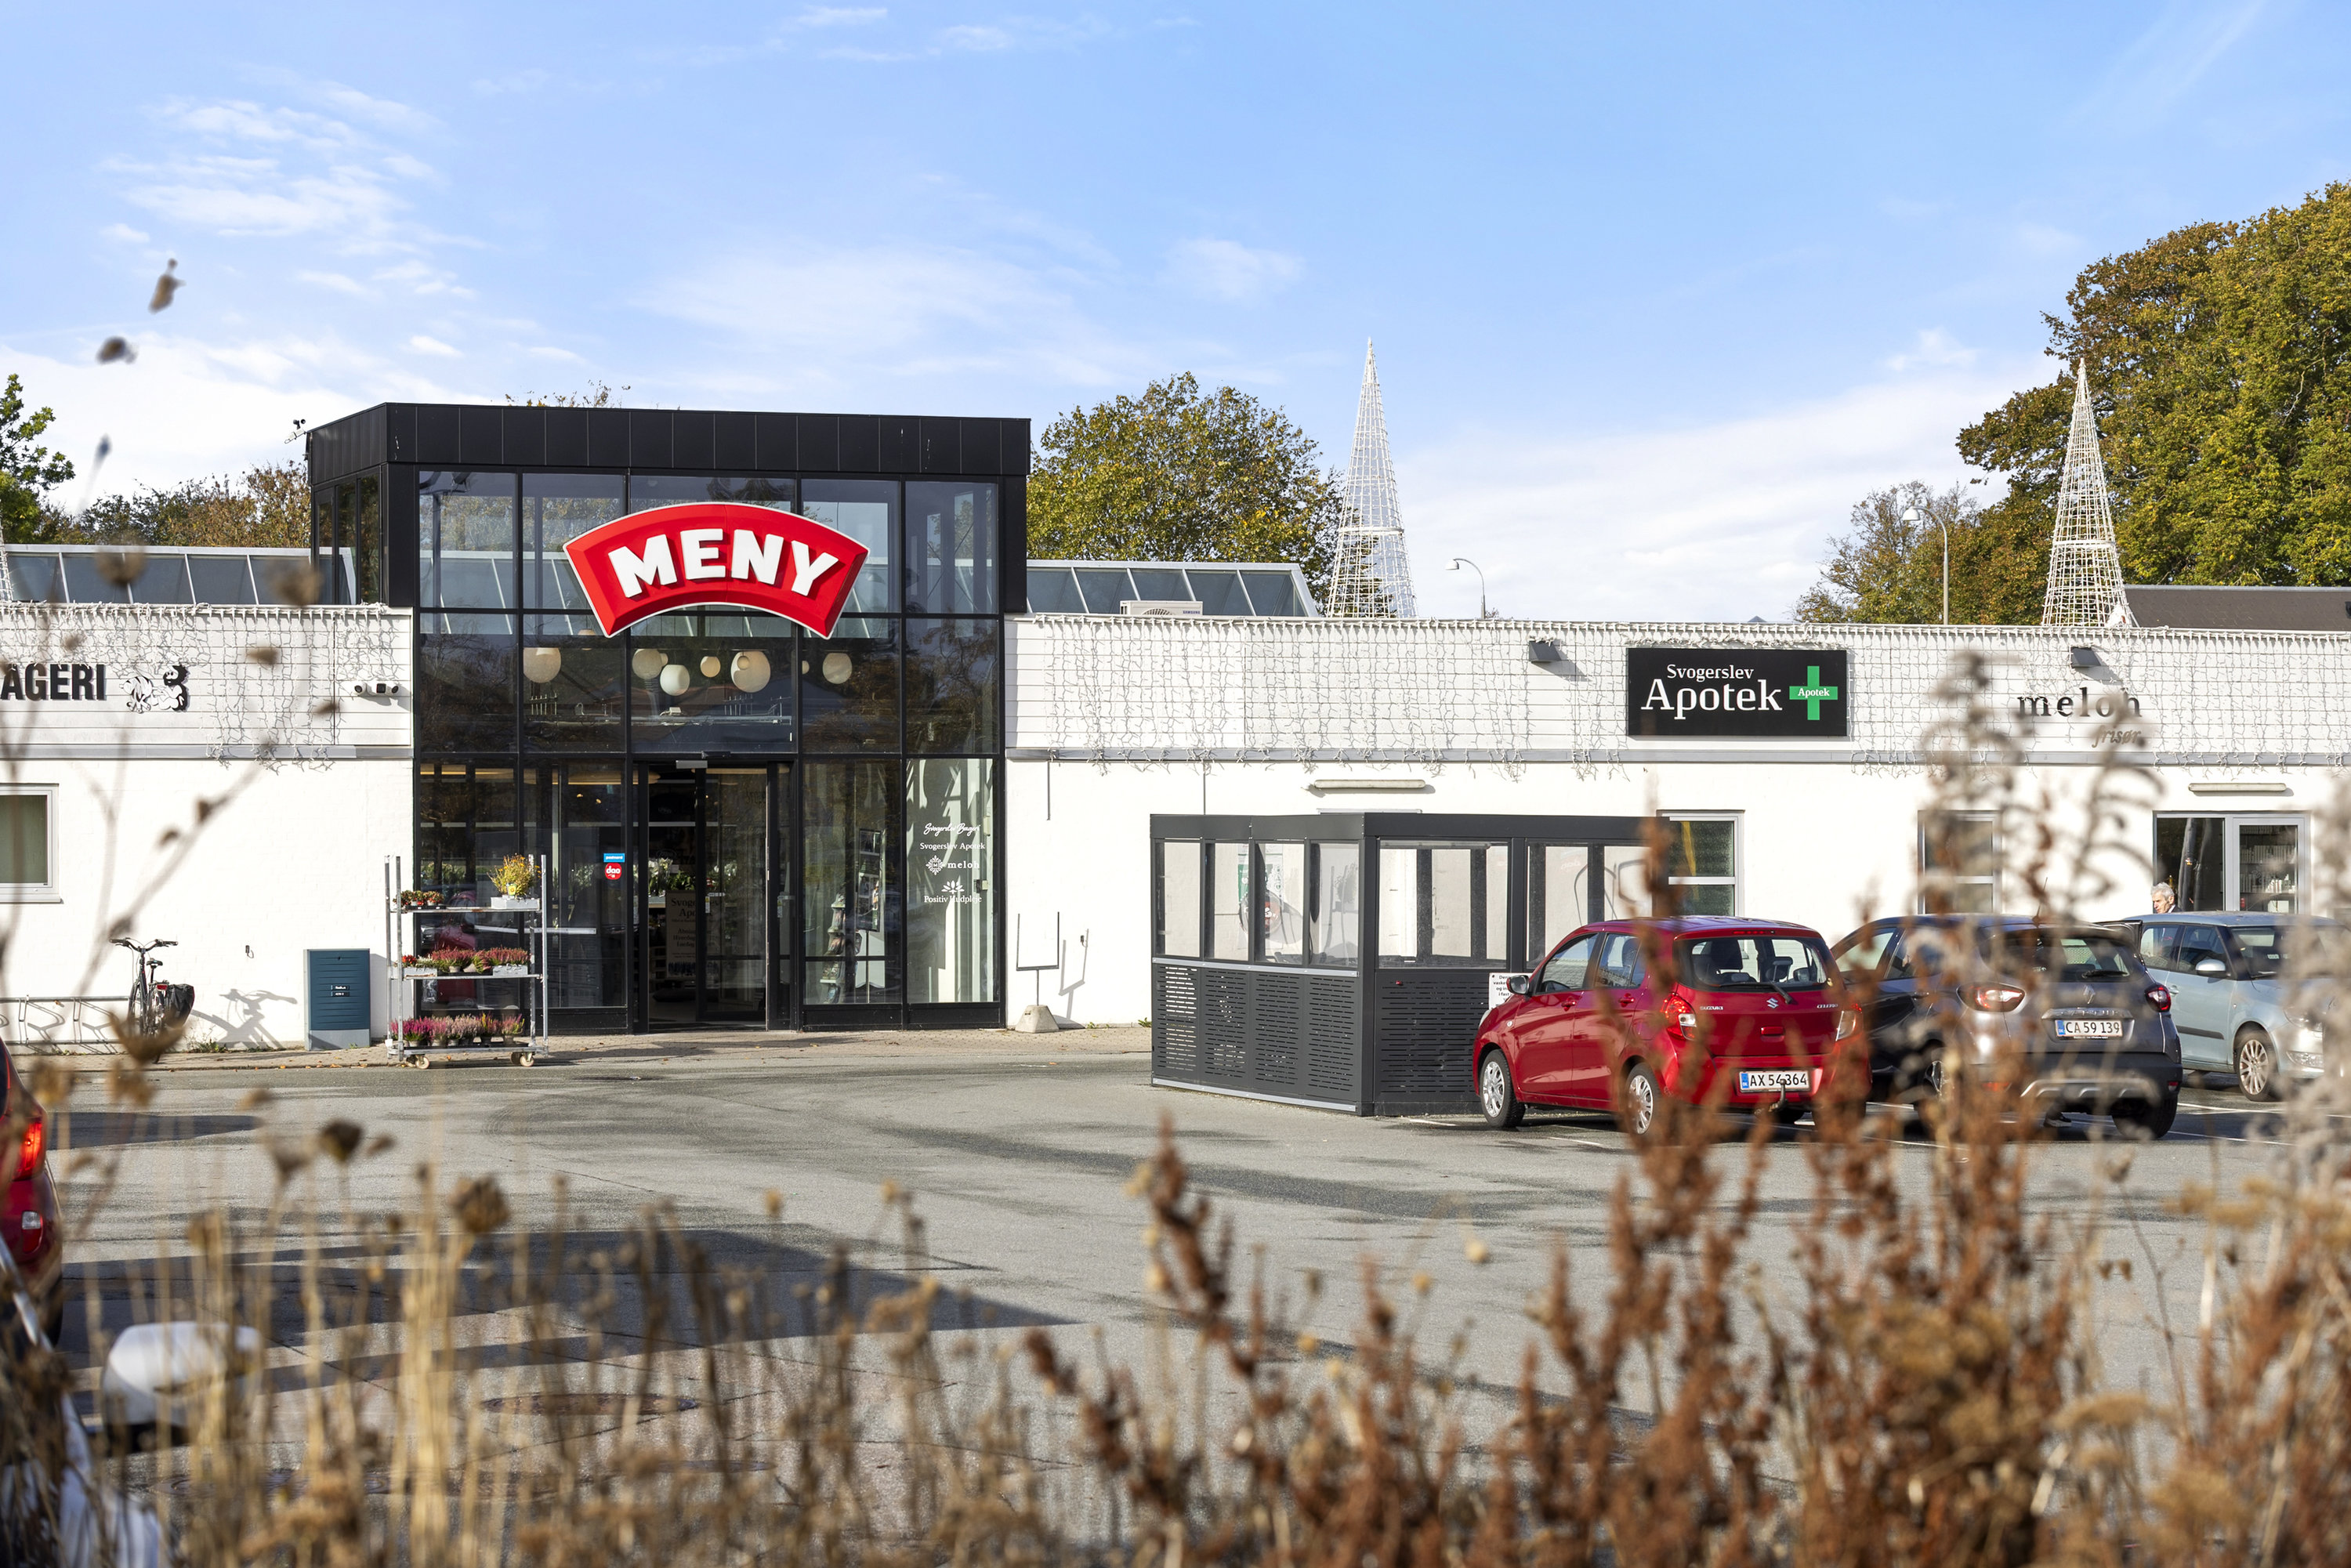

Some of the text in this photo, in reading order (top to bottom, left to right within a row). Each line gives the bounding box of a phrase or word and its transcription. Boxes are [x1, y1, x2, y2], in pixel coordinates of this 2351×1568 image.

[608, 528, 839, 598] MENY
[0, 663, 107, 701] AGERI
[1667, 664, 1755, 683] Svogerslev
[1641, 679, 1783, 720] Apotek
[1798, 688, 1830, 698] Apotek
[2016, 687, 2143, 718] meloh
[2092, 725, 2142, 748] frisør
[920, 842, 985, 851] Svogerslev Apotek
[607, 865, 620, 874] dao
[2066, 1022, 2081, 1034] CA
[2084, 1022, 2097, 1034] 59
[2101, 1022, 2120, 1034] 139
[1750, 1074, 1766, 1086] AX
[1768, 1074, 1782, 1086] 54
[1785, 1074, 1807, 1085] 364
